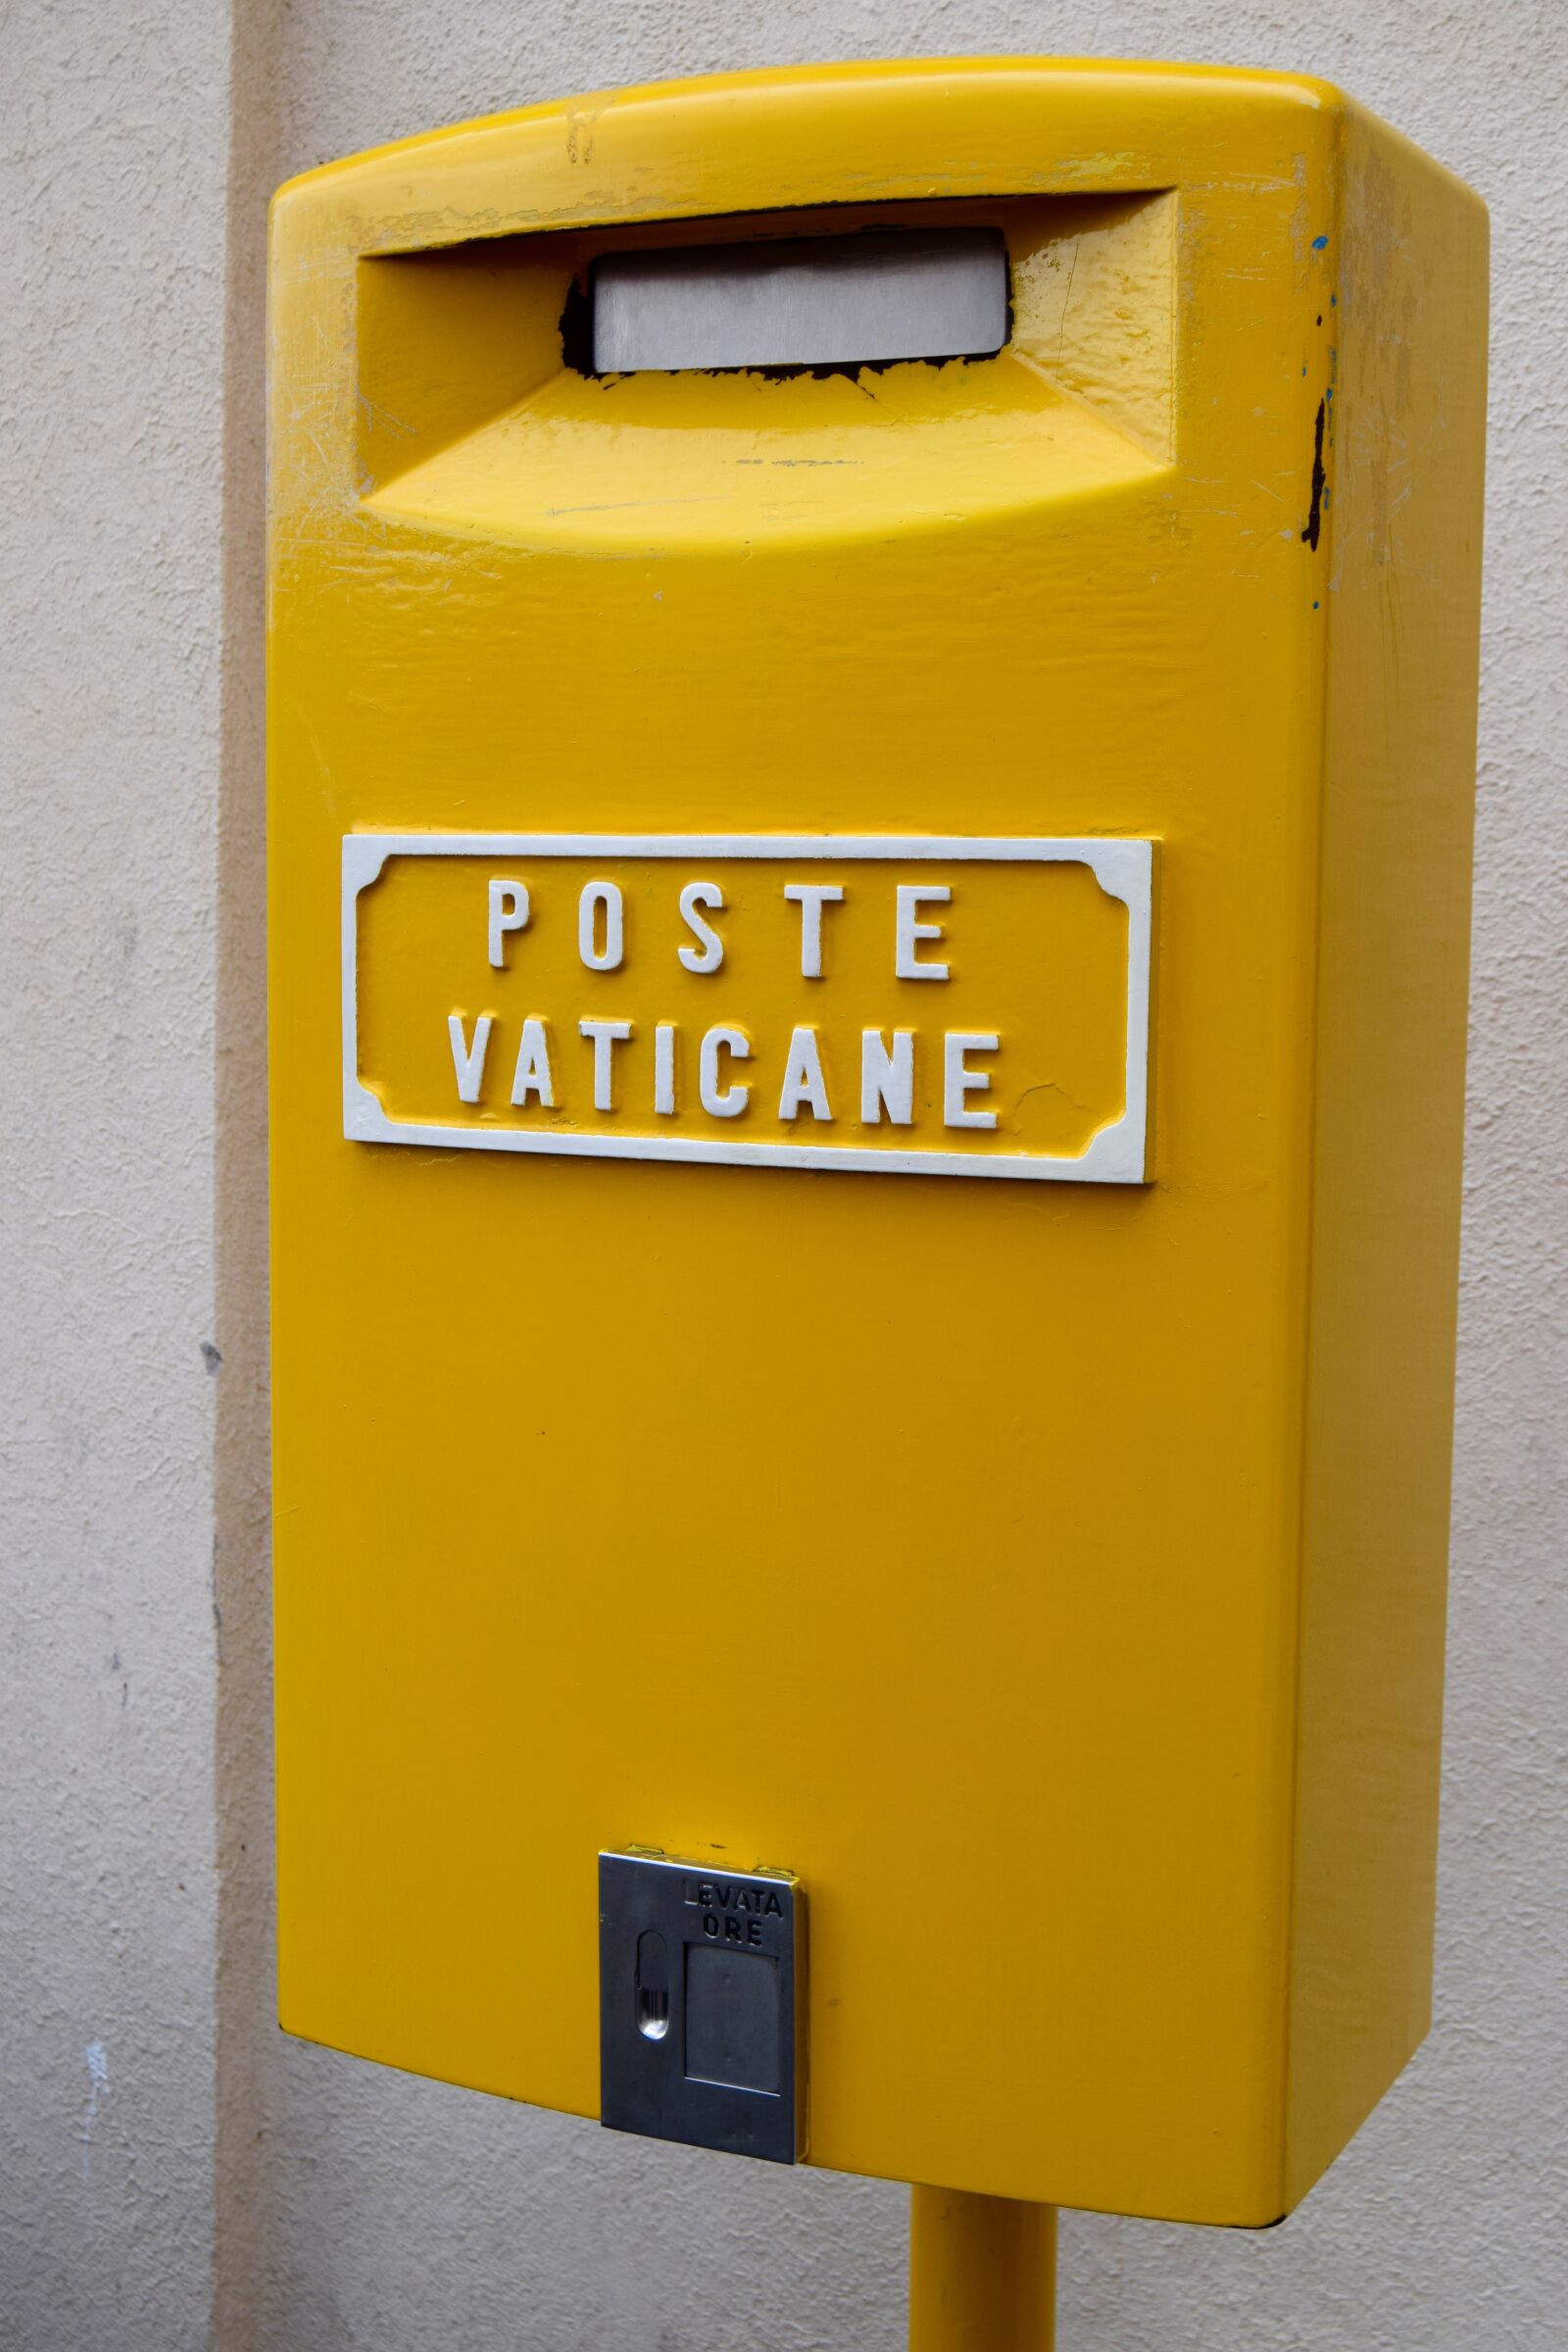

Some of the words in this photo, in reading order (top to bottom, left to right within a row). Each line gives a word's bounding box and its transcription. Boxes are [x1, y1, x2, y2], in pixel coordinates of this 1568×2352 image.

[487, 879, 952, 980] POSTE
[447, 1013, 1000, 1130] VATICANE
[683, 1880, 783, 1918] LEVATA
[704, 1914, 762, 1945] ORE
